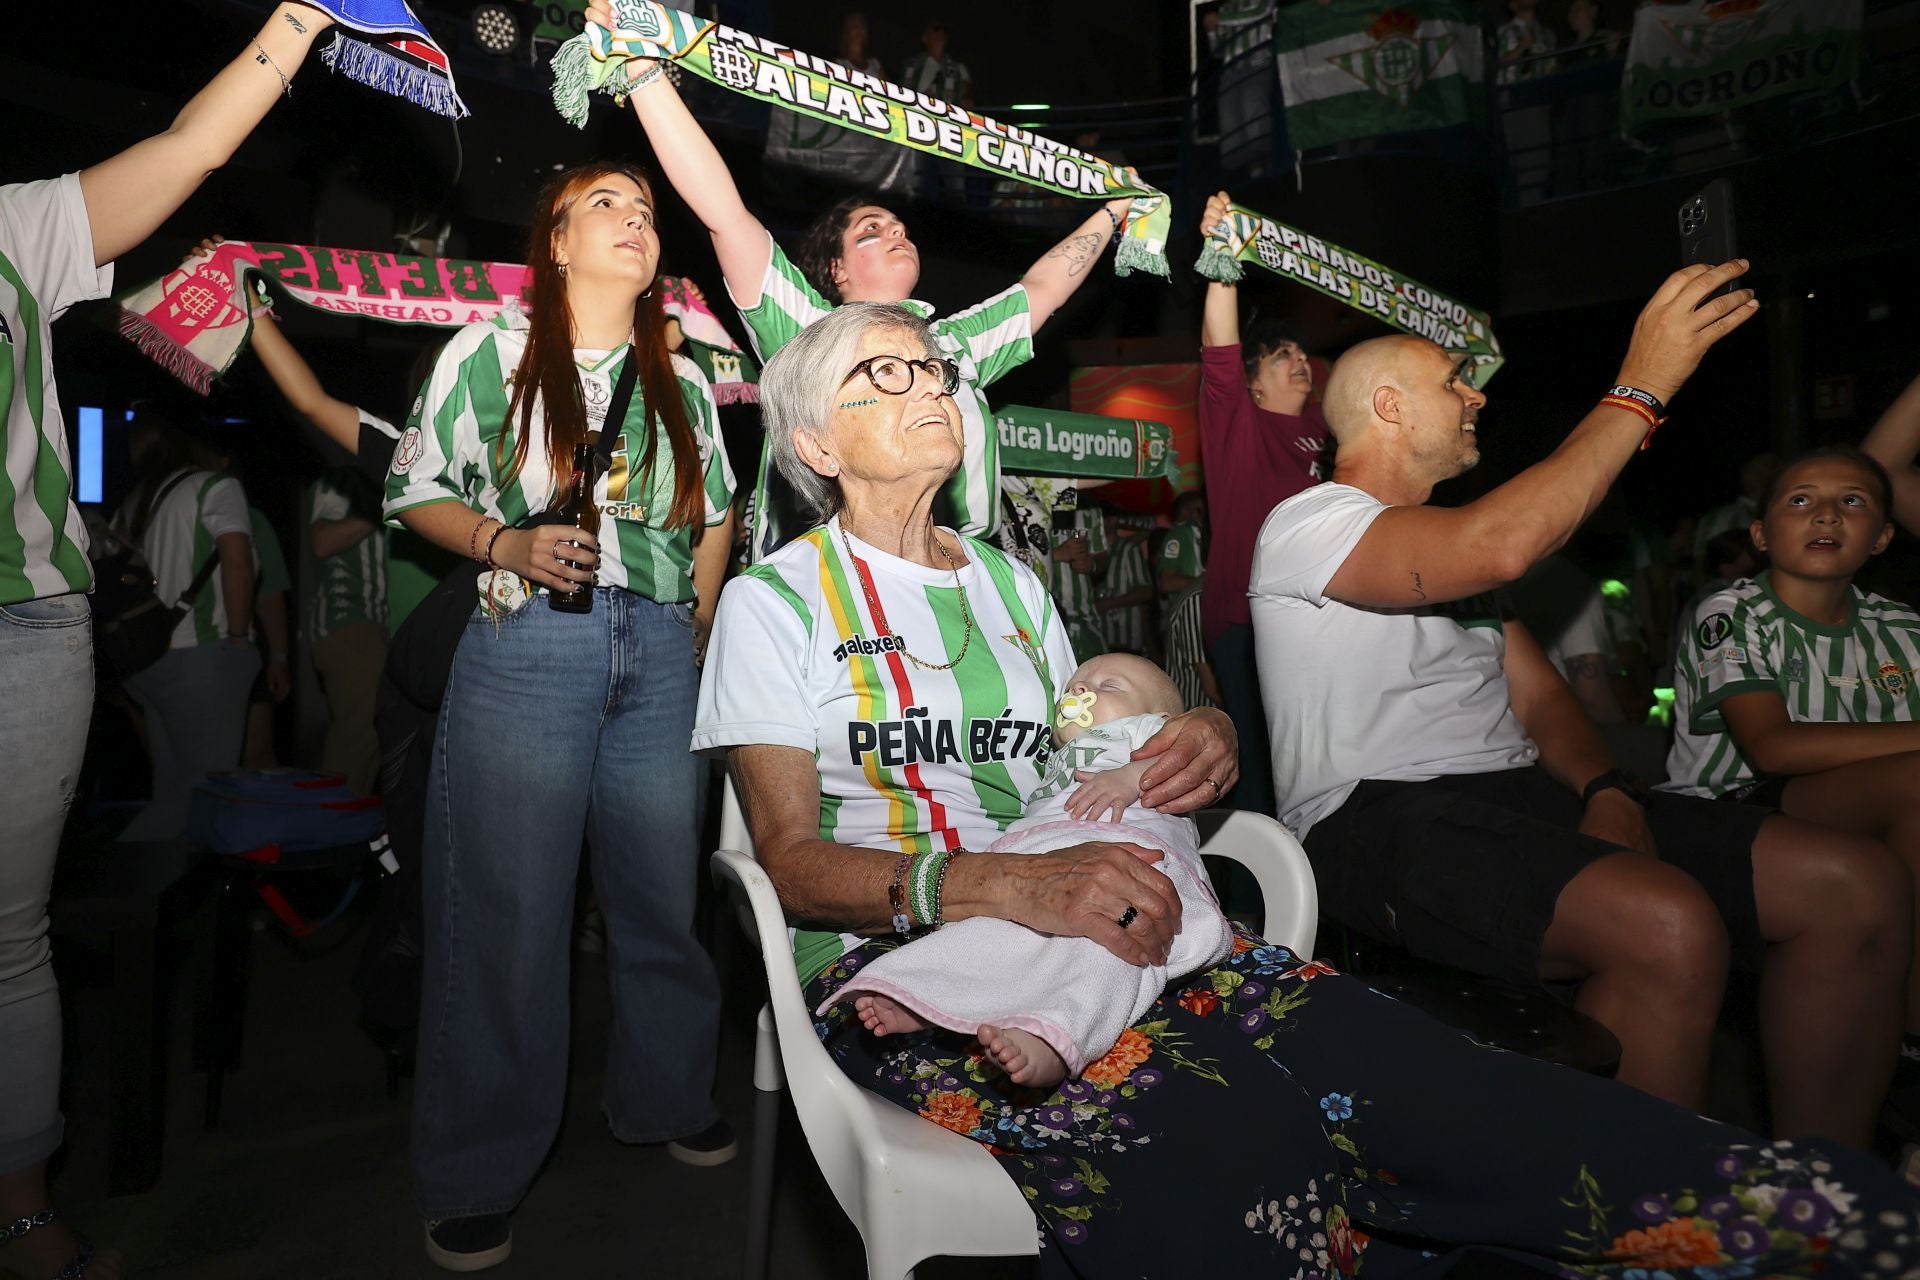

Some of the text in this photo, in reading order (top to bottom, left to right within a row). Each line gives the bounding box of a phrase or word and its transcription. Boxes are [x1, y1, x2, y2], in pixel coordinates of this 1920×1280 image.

[755, 59, 892, 132] ALAS
[904, 108, 963, 156] DE
[1636, 42, 1839, 109] OGROÑO
[1261, 217, 1467, 326] APIÑADOS COMO
[1281, 251, 1351, 298] ALAS
[1358, 284, 1391, 315] DE
[1045, 422, 1133, 461] Logroño
[849, 706, 963, 766] PEÑA
